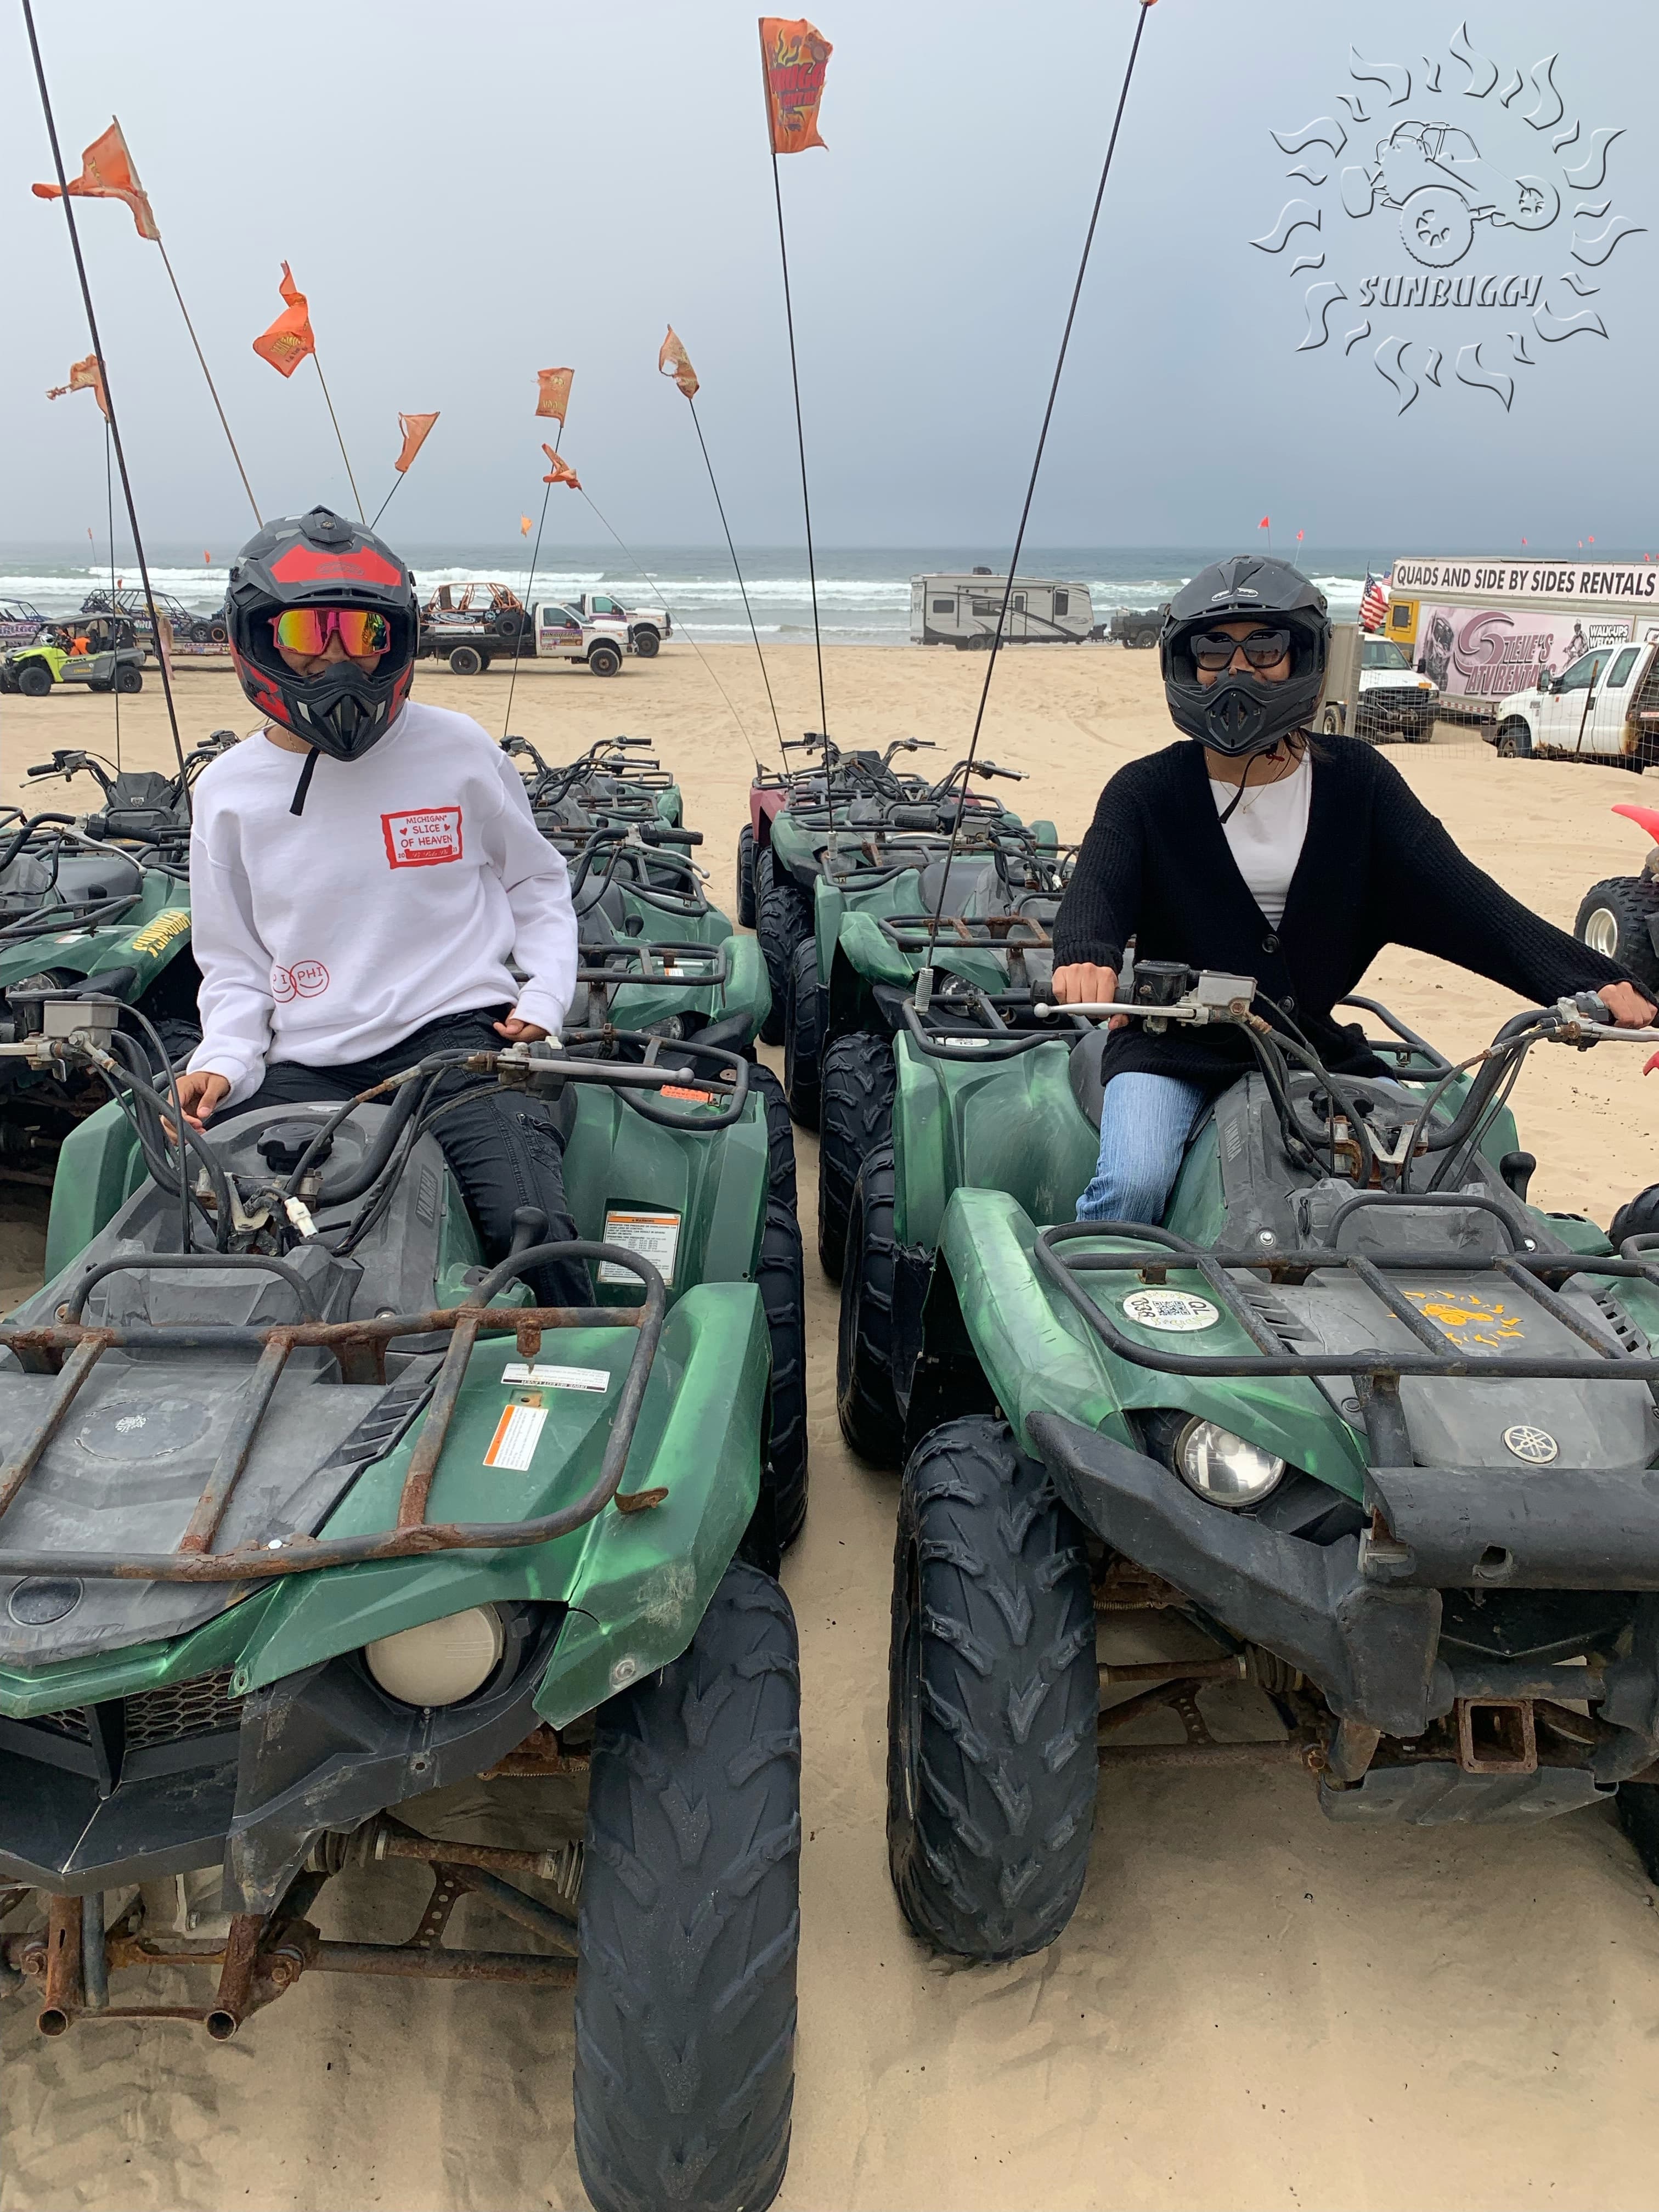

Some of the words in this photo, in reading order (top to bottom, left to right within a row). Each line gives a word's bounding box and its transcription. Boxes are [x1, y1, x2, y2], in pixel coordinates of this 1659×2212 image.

[1397, 566, 1439, 586] QUADS
[1441, 567, 1471, 588] AND
[1474, 568, 1506, 589] SIDE
[1509, 570, 1529, 590] BY
[1531, 570, 1576, 593] SIDES
[1579, 572, 1656, 596] RENTALS
[1589, 624, 1629, 637] WALK-UPS
[1465, 665, 1498, 695] ATV
[413, 824, 440, 834] SLICE
[401, 838, 414, 848] OF
[419, 834, 453, 846] HEAVEN
[297, 967, 323, 981] PHI
[1224, 1118, 1242, 1162] YAMAHA
[417, 1169, 437, 1222] YAMAHA
[1131, 1297, 1156, 1318] 038
[1188, 1301, 1210, 1315] QL
